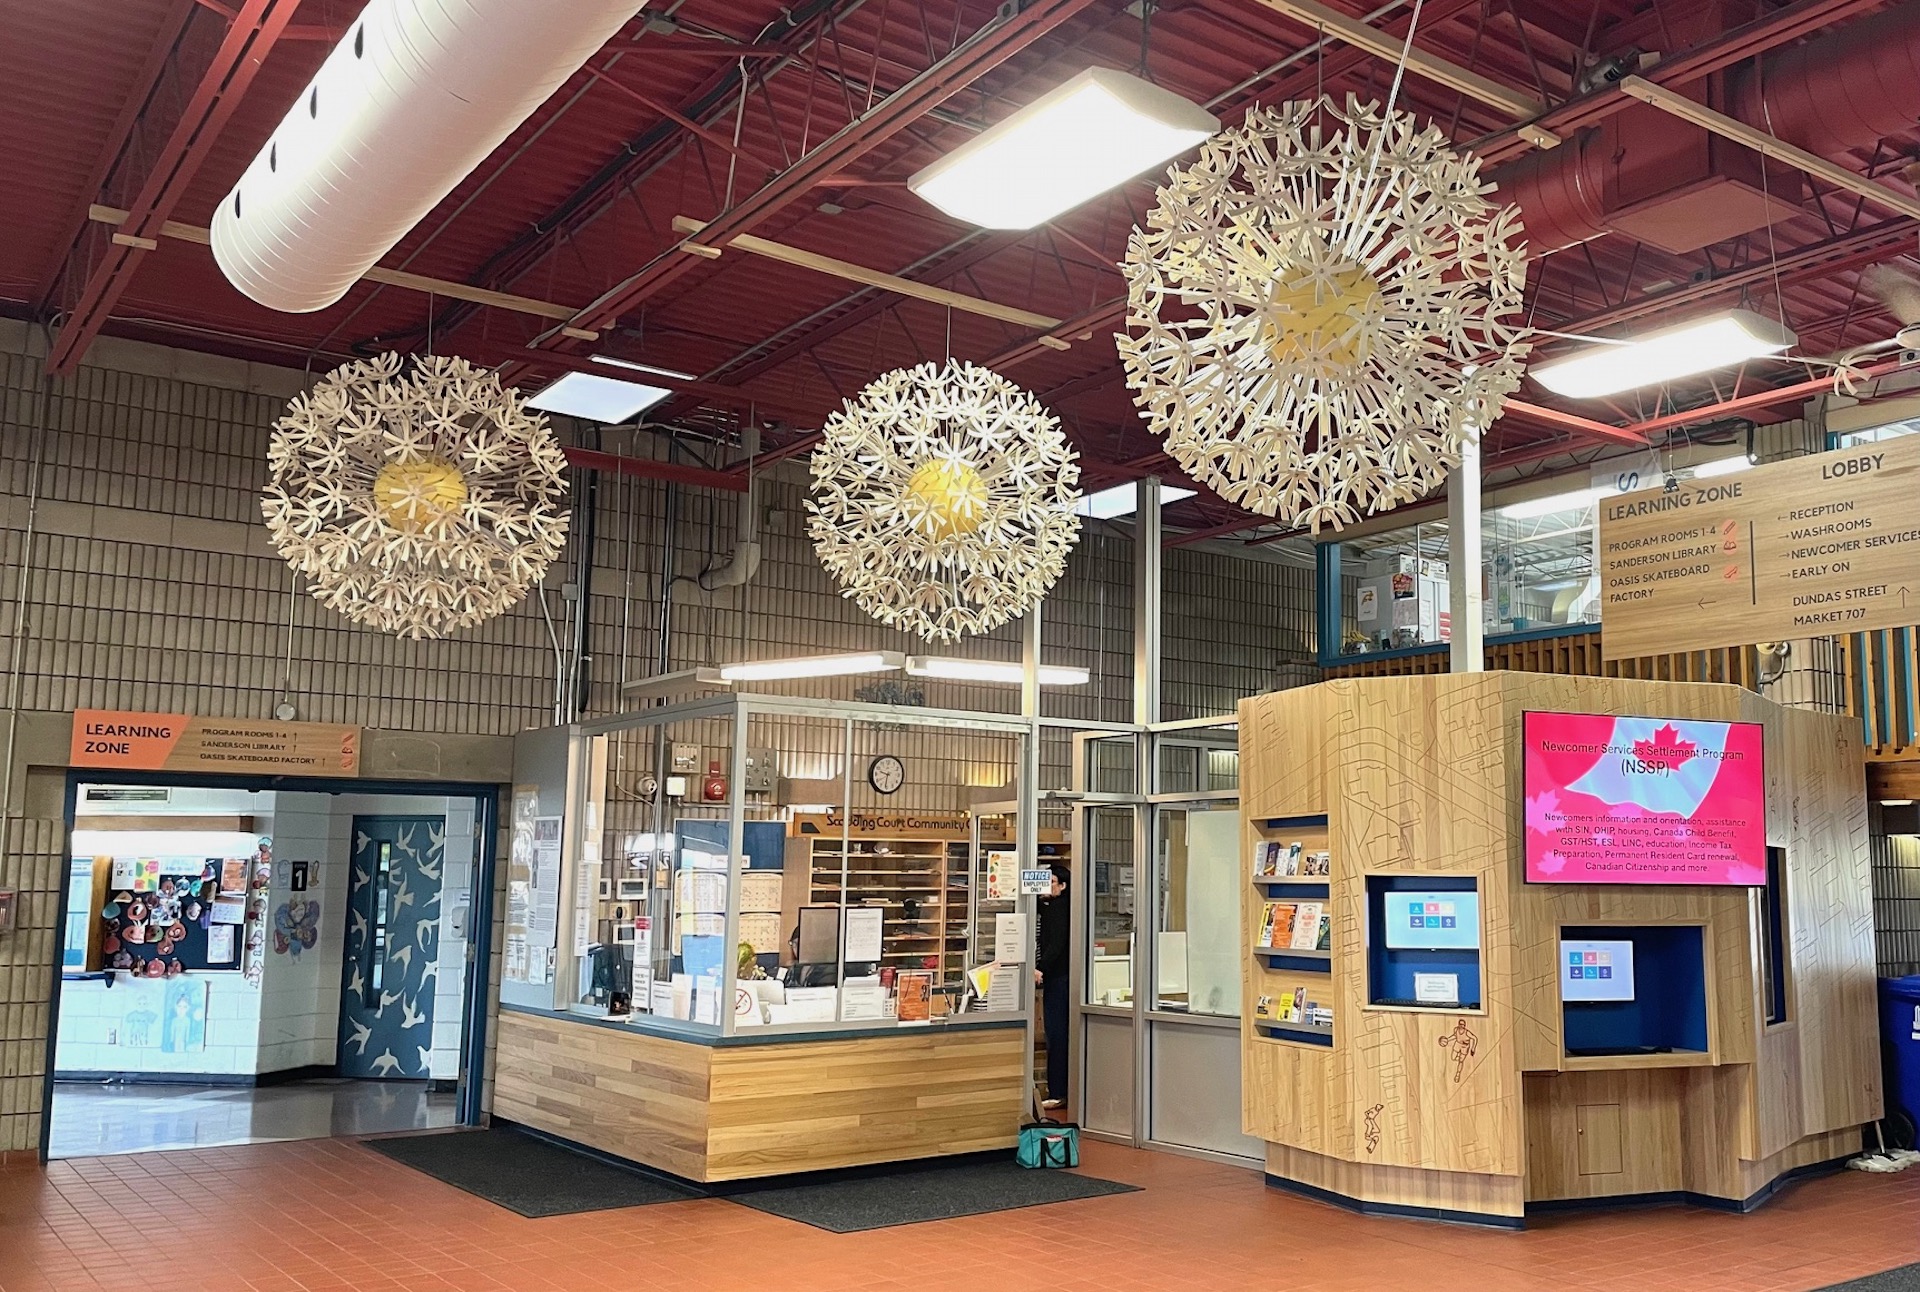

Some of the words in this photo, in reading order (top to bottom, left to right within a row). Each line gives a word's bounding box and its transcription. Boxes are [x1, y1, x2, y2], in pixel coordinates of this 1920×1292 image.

[1823, 453, 1885, 479] LOBBY
[1609, 492, 1691, 521] LEARNING
[1696, 482, 1742, 505] ZONE
[1790, 501, 1854, 520] RECEPTION
[1791, 518, 1872, 540] WASHROOMS
[1609, 536, 1658, 552] PROGRAM
[1661, 529, 1698, 543] ROOMS
[1701, 526, 1716, 537] 1-4
[1791, 540, 1861, 559] NEWCOMER
[1865, 530, 1920, 548] SERVICE
[1610, 552, 1670, 570] SANDERSON
[1672, 544, 1717, 559] LIBRARY
[1610, 575, 1640, 588] OASIS
[1642, 564, 1710, 583] SKATEBOARD
[1792, 564, 1828, 579] EARLY
[1832, 562, 1850, 573] ON
[1610, 588, 1654, 603] FACTORY
[1793, 591, 1841, 607] DUNDAS
[1845, 584, 1888, 600] STREET
[1794, 611, 1842, 626] MARKET
[1846, 608, 1866, 620] 707
[86, 723, 171, 739] LEARNING
[201, 728, 243, 737] PROGRAM
[244, 730, 274, 739] ROOMS
[84, 741, 130, 755] ZONE
[201, 740, 251, 749] SANDERSON
[252, 743, 286, 751] LIBRARY
[1542, 740, 1599, 753] Newcomer
[1601, 743, 1644, 756] Services
[1646, 746, 1700, 758] Settlement
[1702, 748, 1744, 762] Program
[227, 754, 280, 763] SKATEBOARD
[281, 757, 316, 765] FACTORY
[1621, 758, 1670, 778] (NSSP)
[907, 817, 965, 832] Community
[1544, 813, 1593, 822] Newcomers
[1595, 814, 1641, 823] information
[1643, 816, 1658, 824] and
[1706, 819, 1746, 827] assistance
[1556, 826, 1573, 834] with
[1594, 826, 1616, 835] OHIP,
[1618, 828, 1652, 837] housing,
[1653, 827, 1684, 837] Canada
[1685, 828, 1705, 837] Child
[1560, 837, 1600, 847] GST/HST,
[1601, 838, 1619, 847] ESL,
[1621, 839, 1644, 848] LINC,
[1645, 840, 1687, 849] education,
[1689, 841, 1717, 849] Income
[1719, 841, 1732, 849] Tax
[1553, 848, 1603, 859] Preparation,
[1605, 850, 1648, 859] Permanent
[1650, 851, 1685, 860] Resident
[1687, 852, 1705, 860] Card
[1023, 871, 1050, 880] NOTICE
[1585, 862, 1623, 871] Canadian
[1625, 863, 1669, 873] Citizenship
[1671, 864, 1686, 872] and
[295, 869, 303, 888] 1
